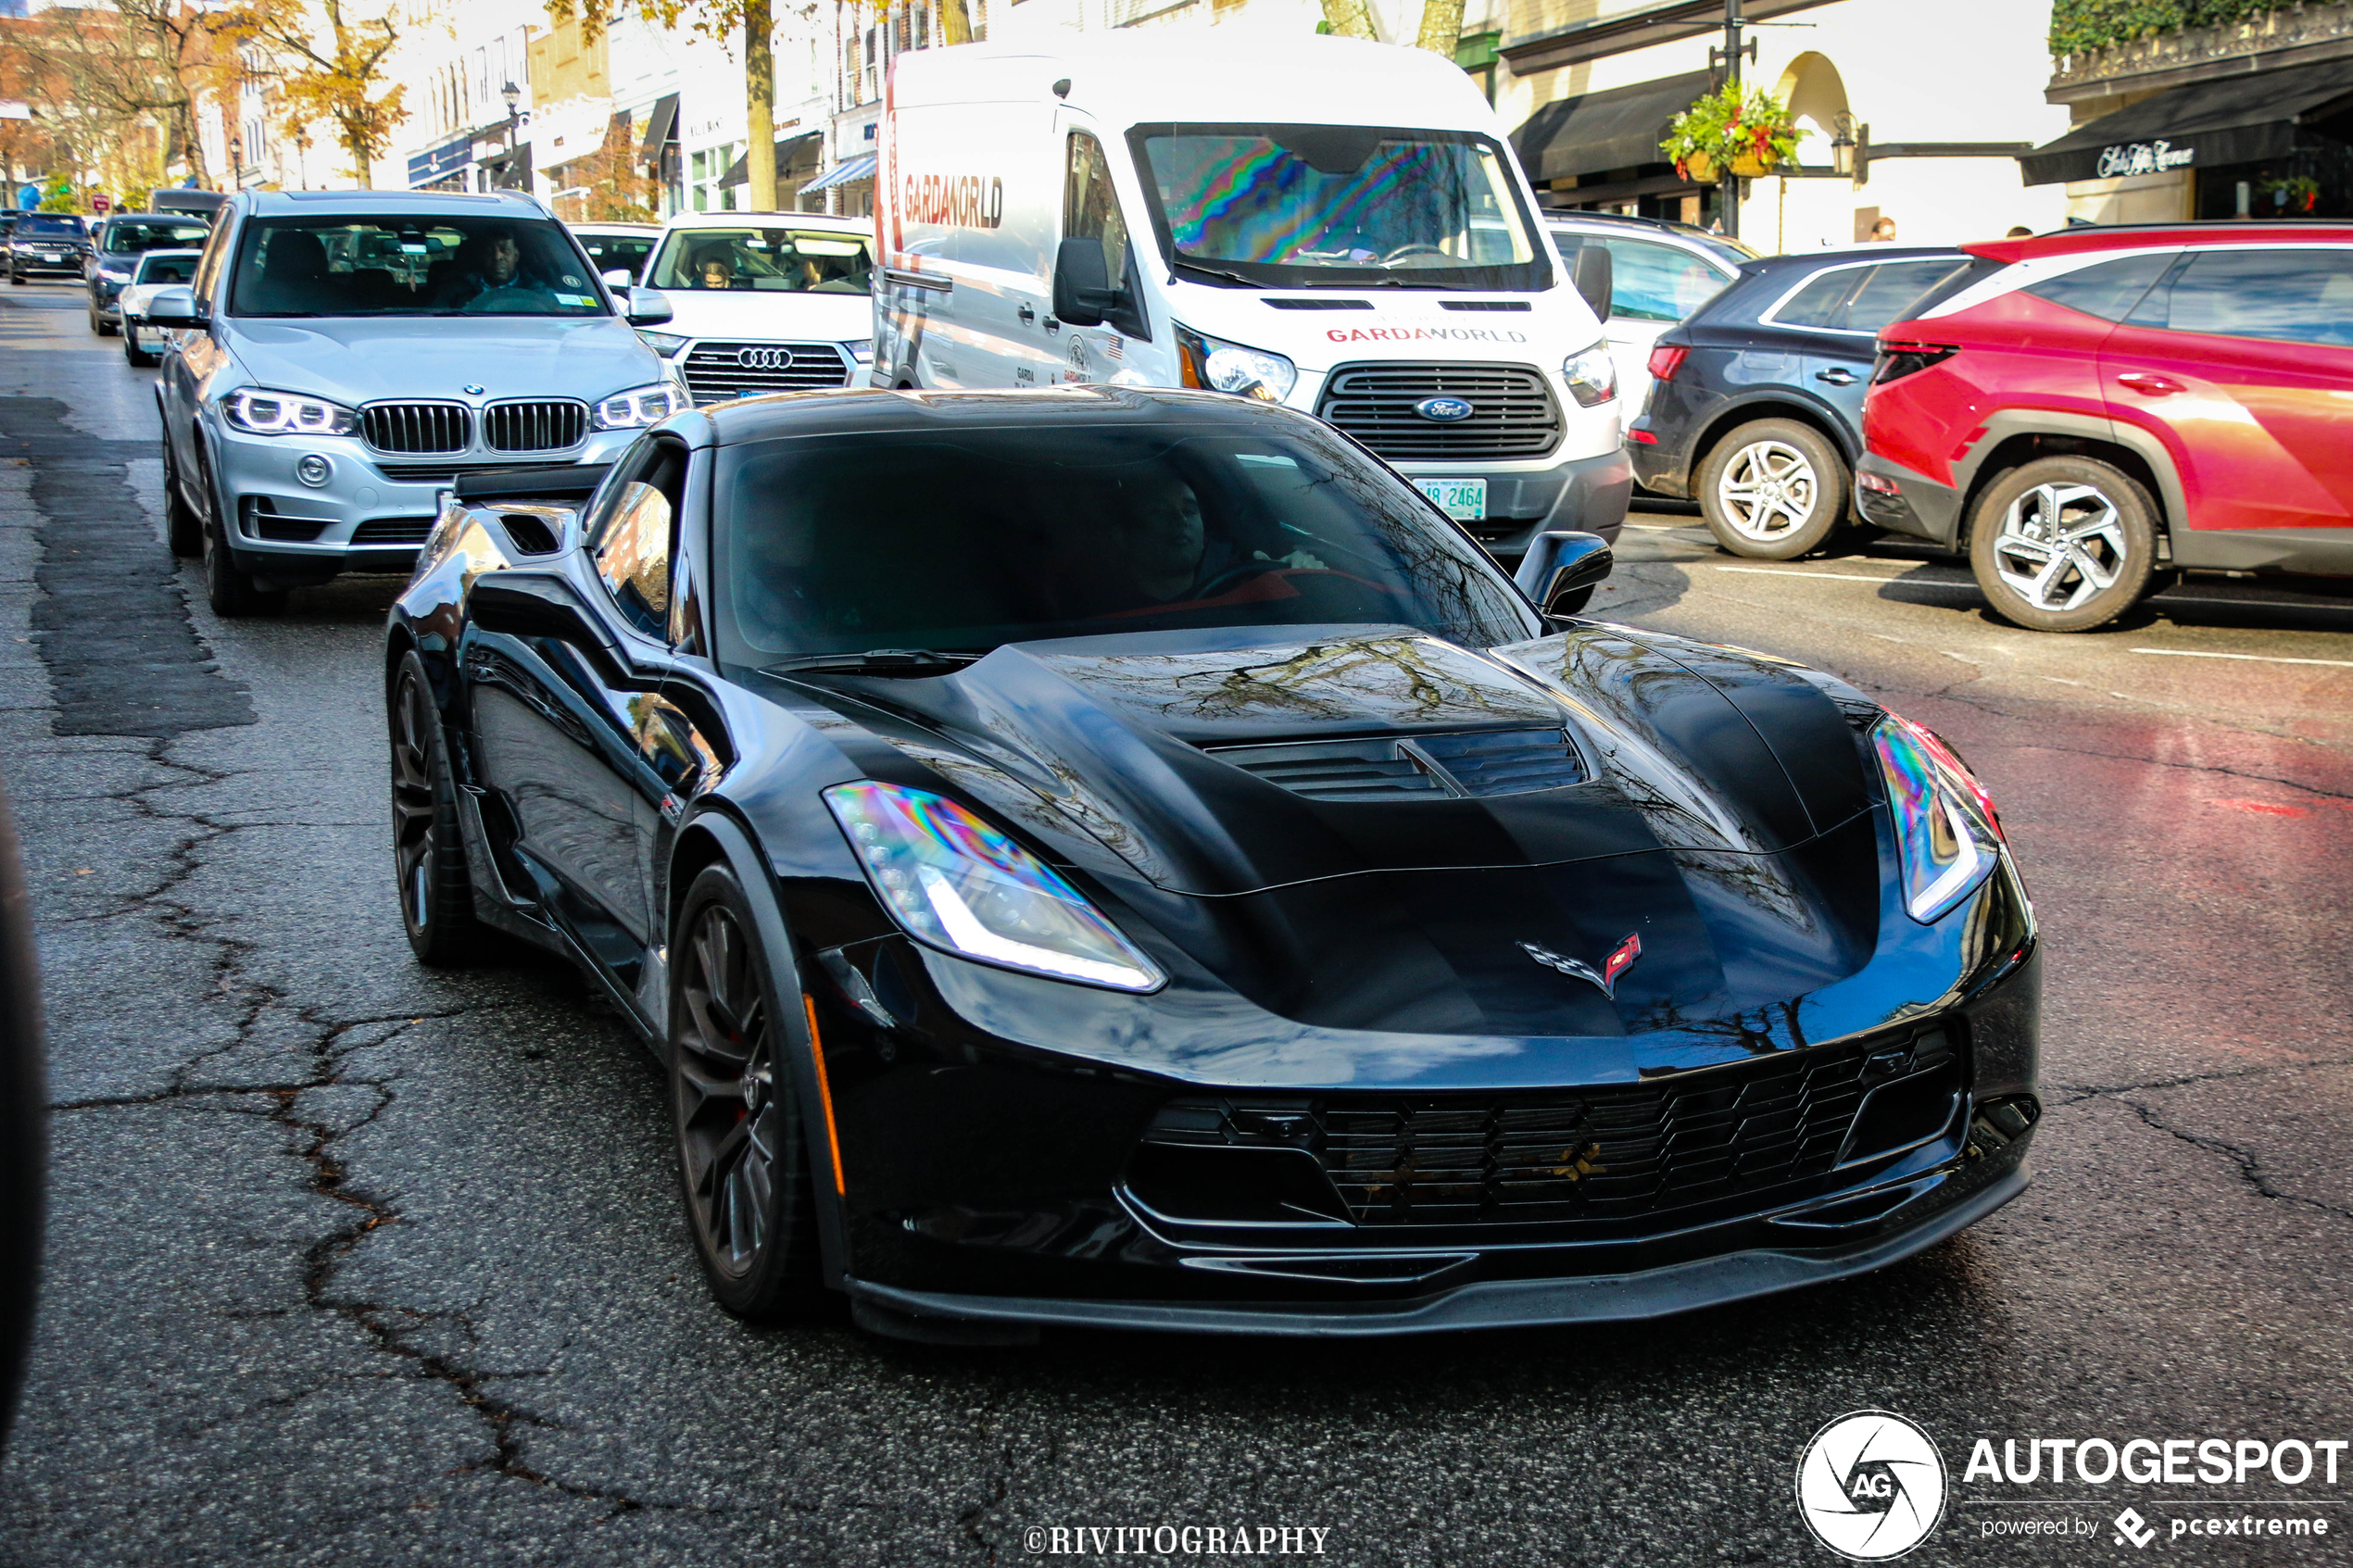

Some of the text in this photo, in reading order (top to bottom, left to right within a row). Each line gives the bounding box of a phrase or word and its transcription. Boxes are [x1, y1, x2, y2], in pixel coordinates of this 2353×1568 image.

[905, 173, 1002, 229] GARDAWORLD
[1327, 328, 1528, 343] GARDAWORLD
[1430, 401, 1461, 416] Ford
[1449, 487, 1482, 507] 2464
